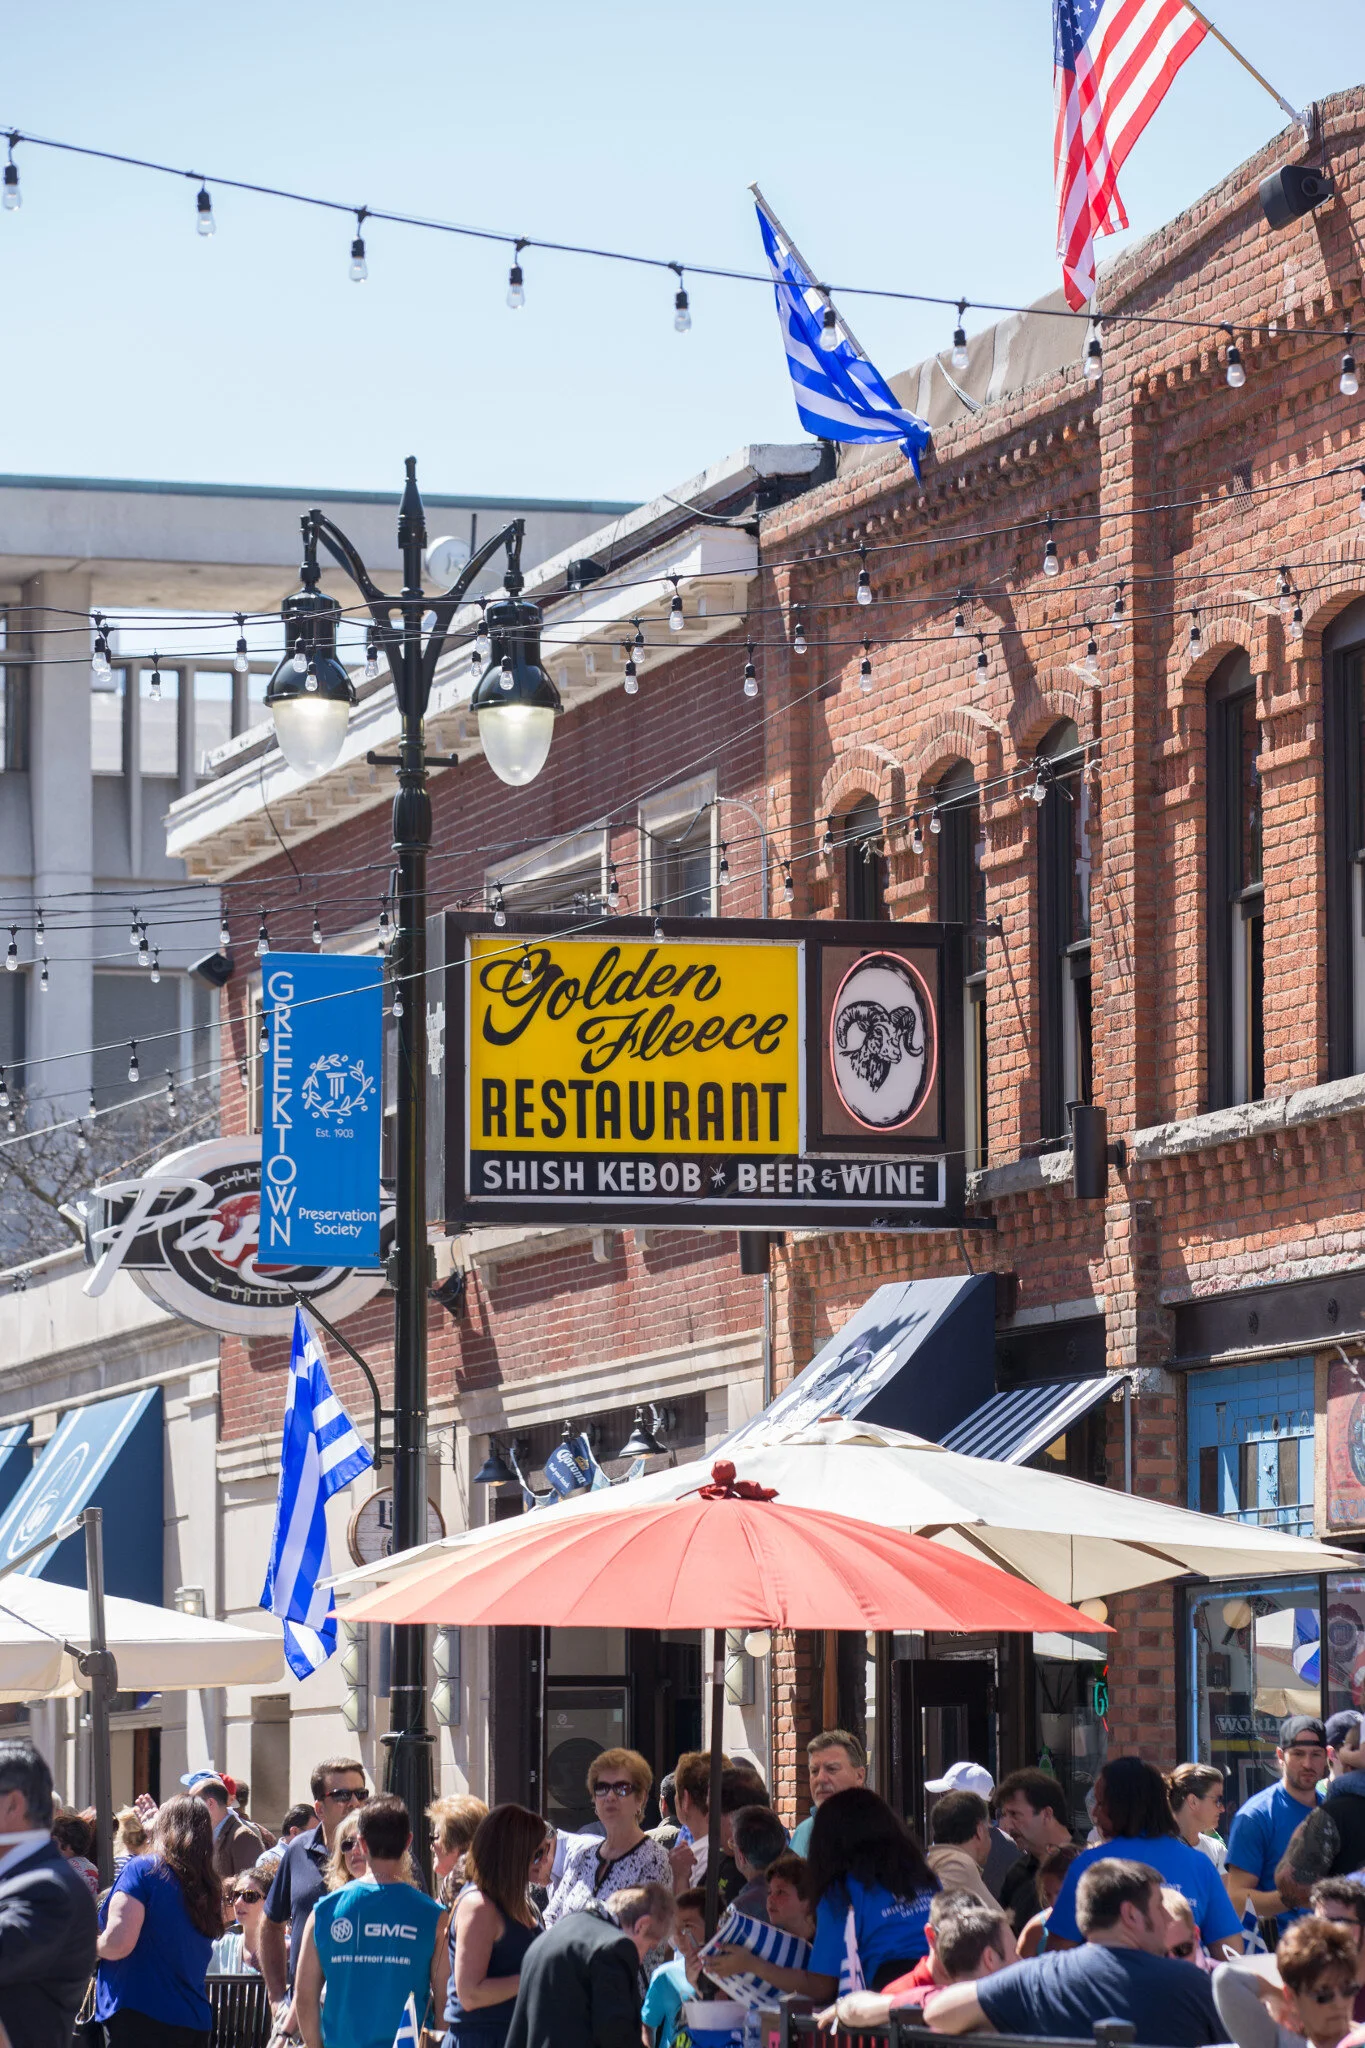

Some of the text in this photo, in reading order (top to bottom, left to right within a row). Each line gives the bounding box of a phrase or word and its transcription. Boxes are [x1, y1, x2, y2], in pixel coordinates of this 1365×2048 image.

[479, 946, 721, 1045] Golden
[576, 1003, 788, 1074] Fleece
[266, 971, 297, 1246] GREEKTOWN
[482, 1078, 787, 1142] RESTAURANT
[315, 1128, 354, 1138] Est. 1903
[219, 1168, 262, 1190] SPOR
[483, 1160, 584, 1190] SHISH
[598, 1161, 701, 1193] KEBOB
[298, 1207, 377, 1222] Preservation
[314, 1222, 362, 1238] Society
[556, 1449, 586, 1485] Corona
[364, 1922, 418, 1940] GMC
